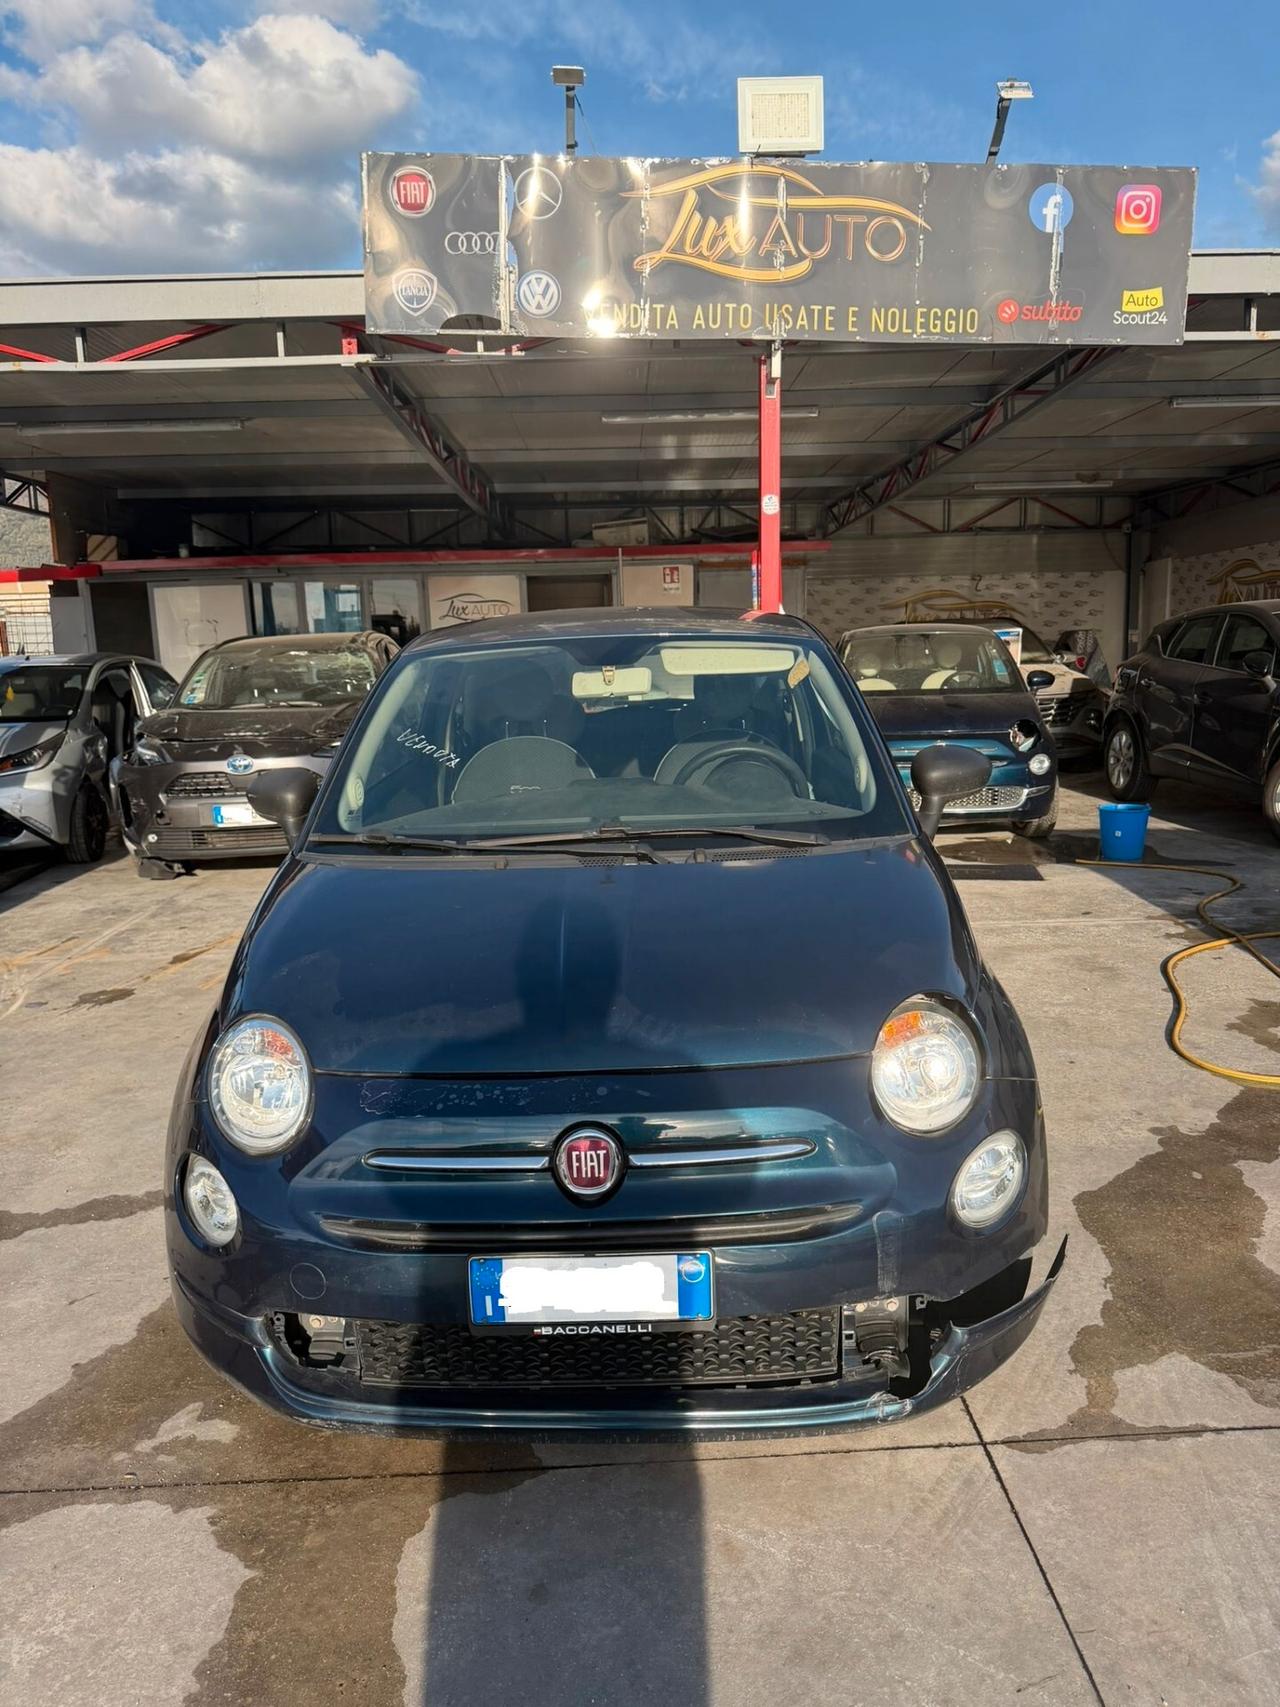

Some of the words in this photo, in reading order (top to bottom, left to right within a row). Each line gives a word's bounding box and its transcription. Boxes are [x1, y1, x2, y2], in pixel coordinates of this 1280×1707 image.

[400, 181, 426, 204] FIAT
[758, 212, 907, 262] AUTO
[401, 284, 429, 297] LANCIA
[1125, 293, 1159, 307] Auto
[583, 303, 679, 330] VNDTA
[693, 303, 752, 330] AUTO
[765, 303, 836, 332] USATE
[848, 306, 859, 332] E
[871, 307, 979, 334] NOLEGGIO
[1021, 299, 1083, 322] subito
[1113, 310, 1168, 326] Scout24
[439, 600, 470, 620] Lux
[471, 604, 511, 617] AUTO
[571, 1149, 607, 1179] FIAT
[540, 1324, 652, 1335] BACCANELLI
